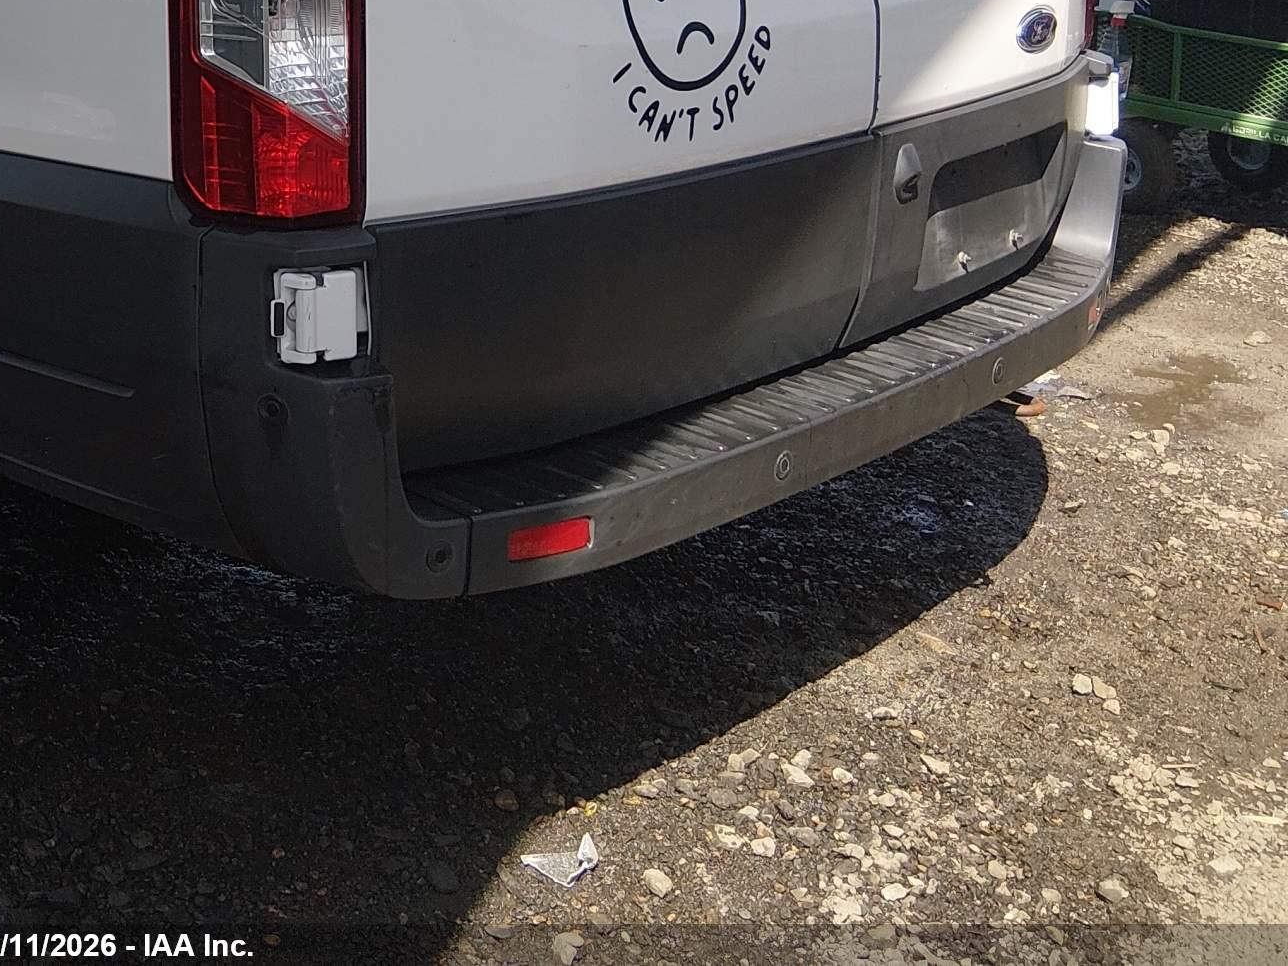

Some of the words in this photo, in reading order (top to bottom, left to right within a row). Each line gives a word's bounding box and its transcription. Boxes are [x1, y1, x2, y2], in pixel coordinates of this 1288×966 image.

[612, 62, 633, 84] I
[628, 86, 700, 143] CAN'T
[712, 25, 771, 131] SPEED
[1273, 133, 1288, 143] CA
